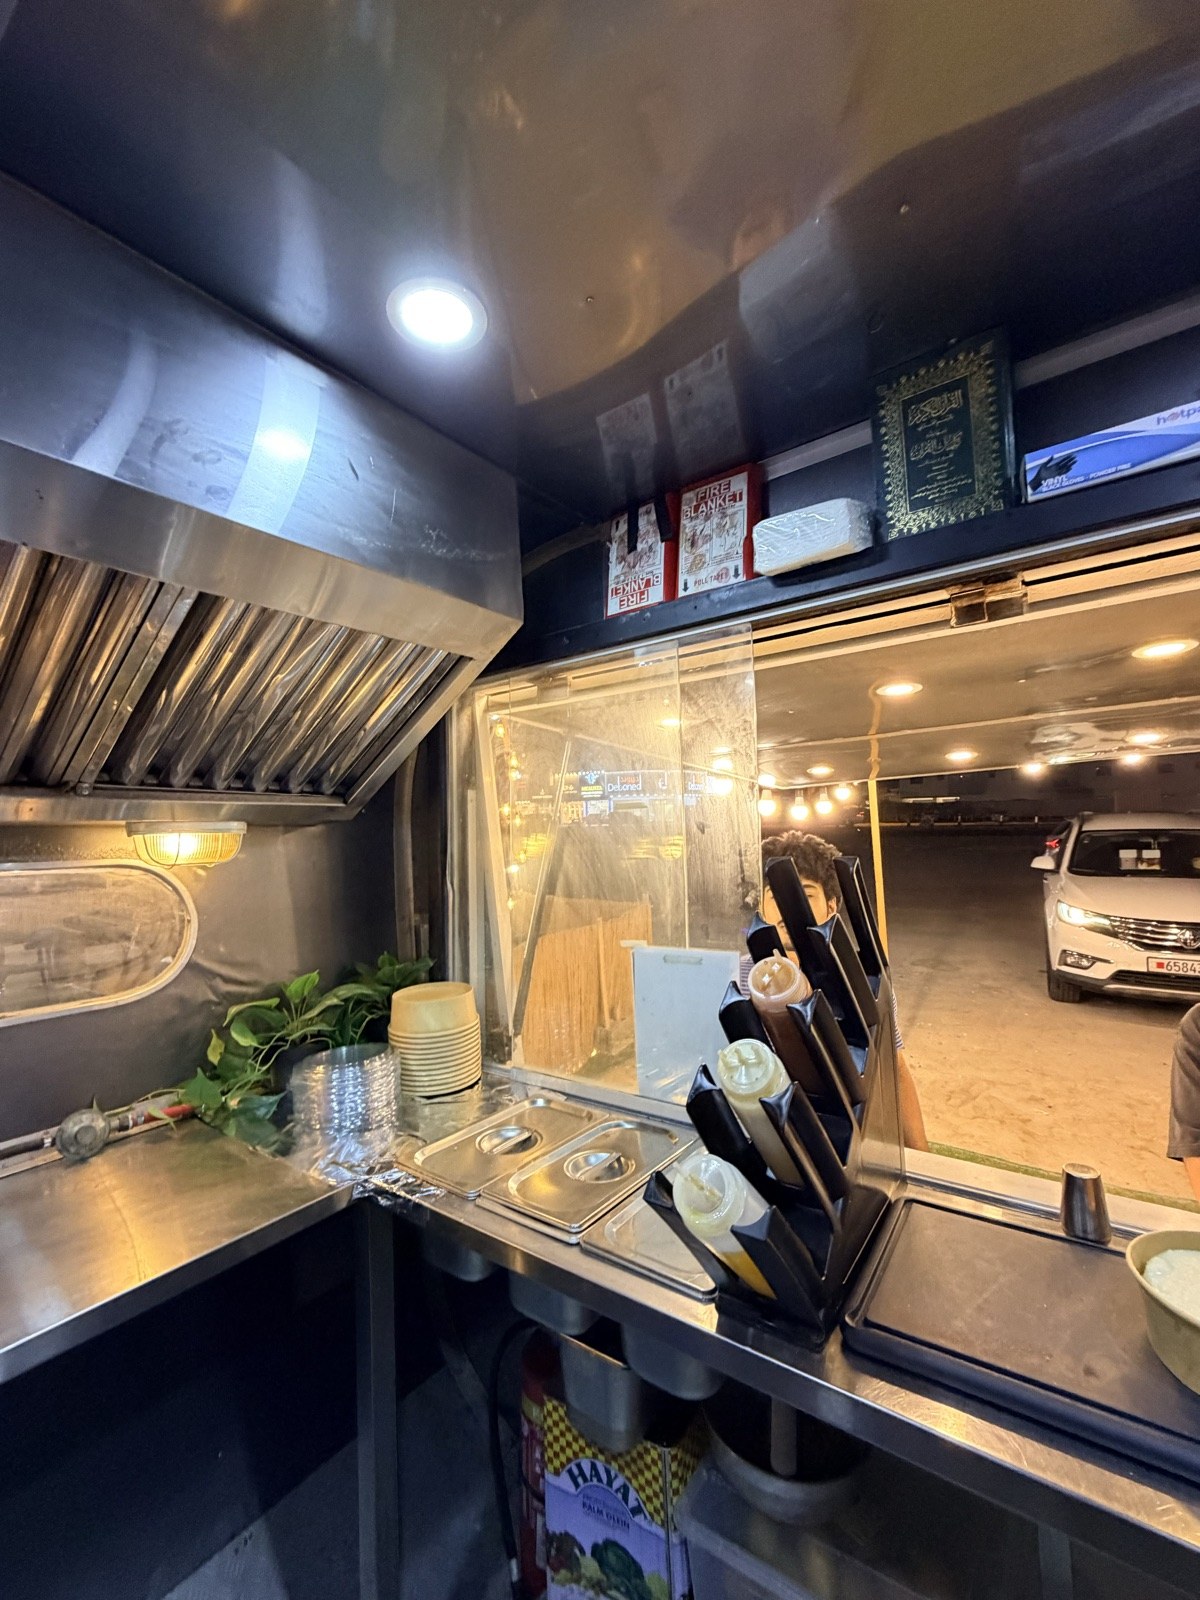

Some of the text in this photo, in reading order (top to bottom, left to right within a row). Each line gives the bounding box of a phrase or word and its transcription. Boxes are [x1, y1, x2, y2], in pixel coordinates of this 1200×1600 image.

[1041, 475, 1068, 488] VINYL
[1062, 476, 1085, 487] GLOVES
[1089, 466, 1117, 480] POWDER
[1117, 462, 1132, 472] FREE
[696, 480, 731, 502] FIRE
[682, 489, 743, 520] BLANKET
[611, 573, 661, 599] BLANKET
[619, 589, 649, 609] FIRE
[566, 1460, 648, 1521] HAYAT
